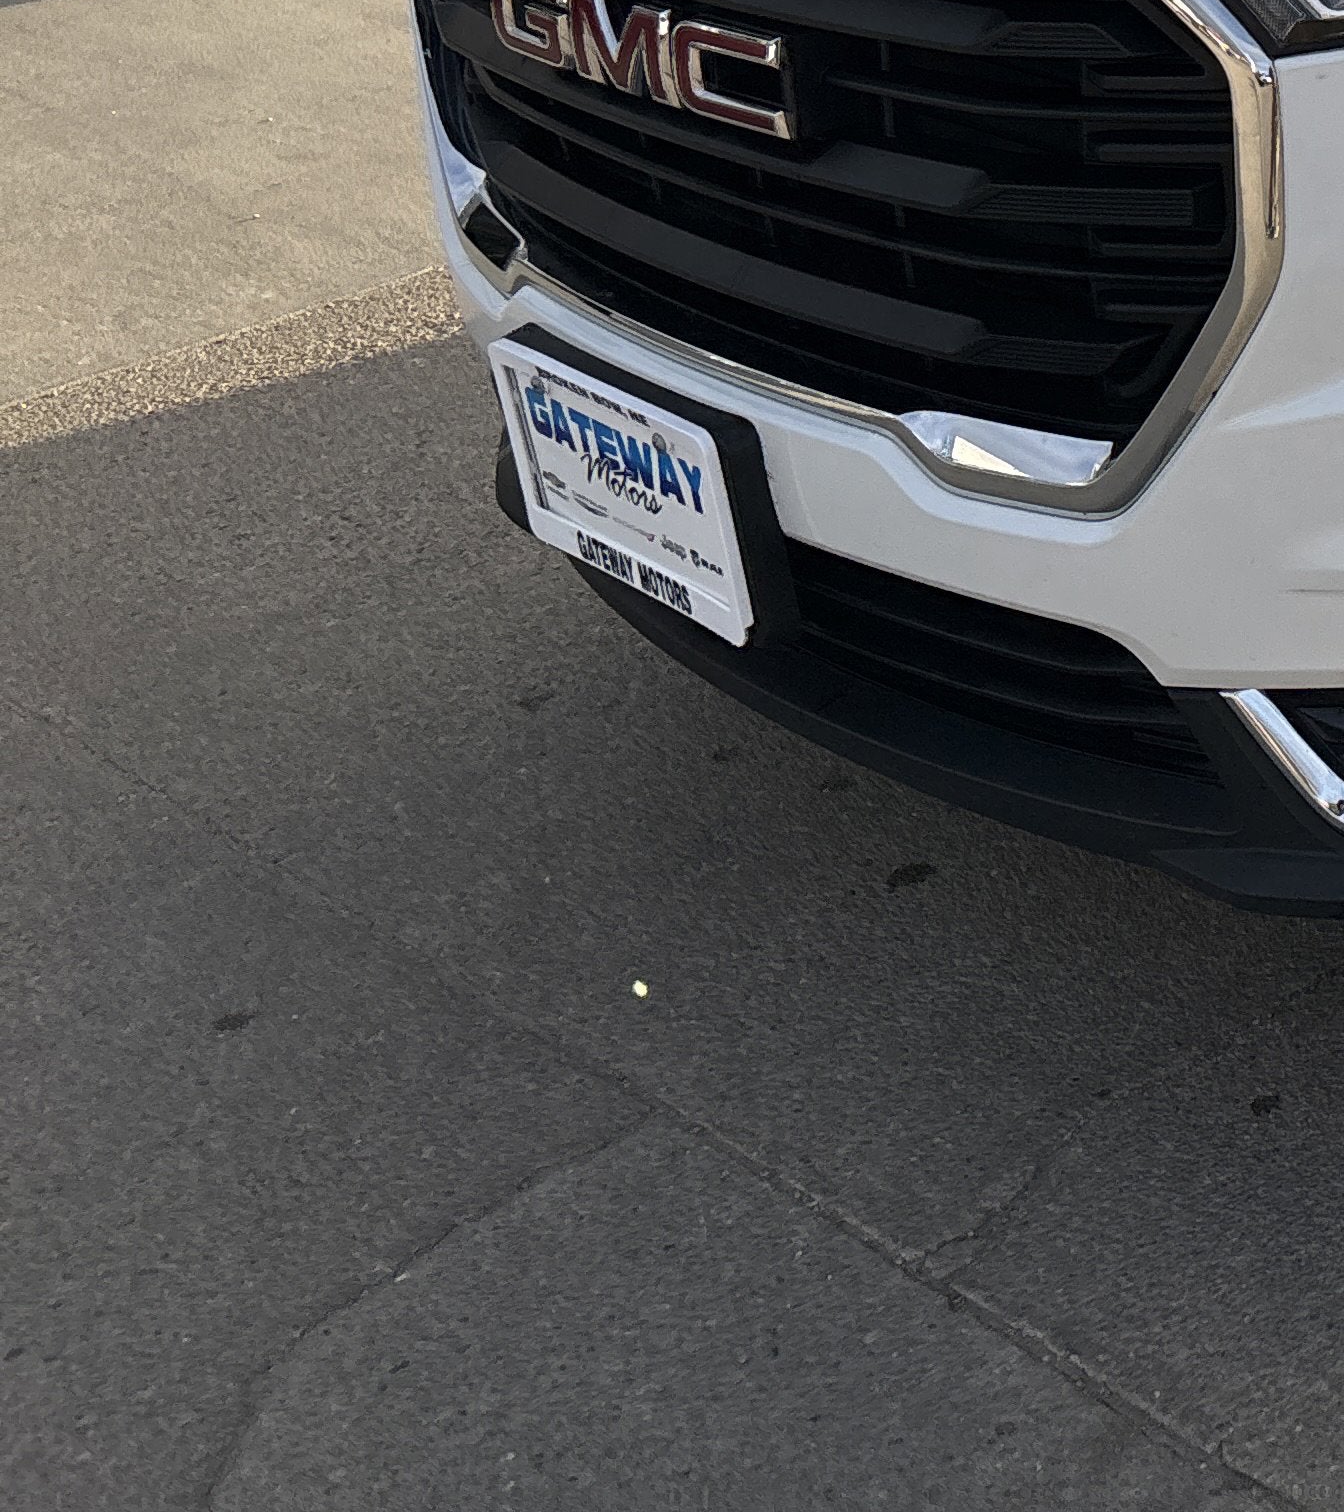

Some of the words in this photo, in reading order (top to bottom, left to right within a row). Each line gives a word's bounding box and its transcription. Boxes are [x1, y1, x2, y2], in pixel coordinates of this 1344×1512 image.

[524, 384, 705, 515] GATEWAY
[581, 453, 663, 516] Motors
[576, 529, 635, 584] GATEWAY
[638, 560, 693, 616] MOTORS
